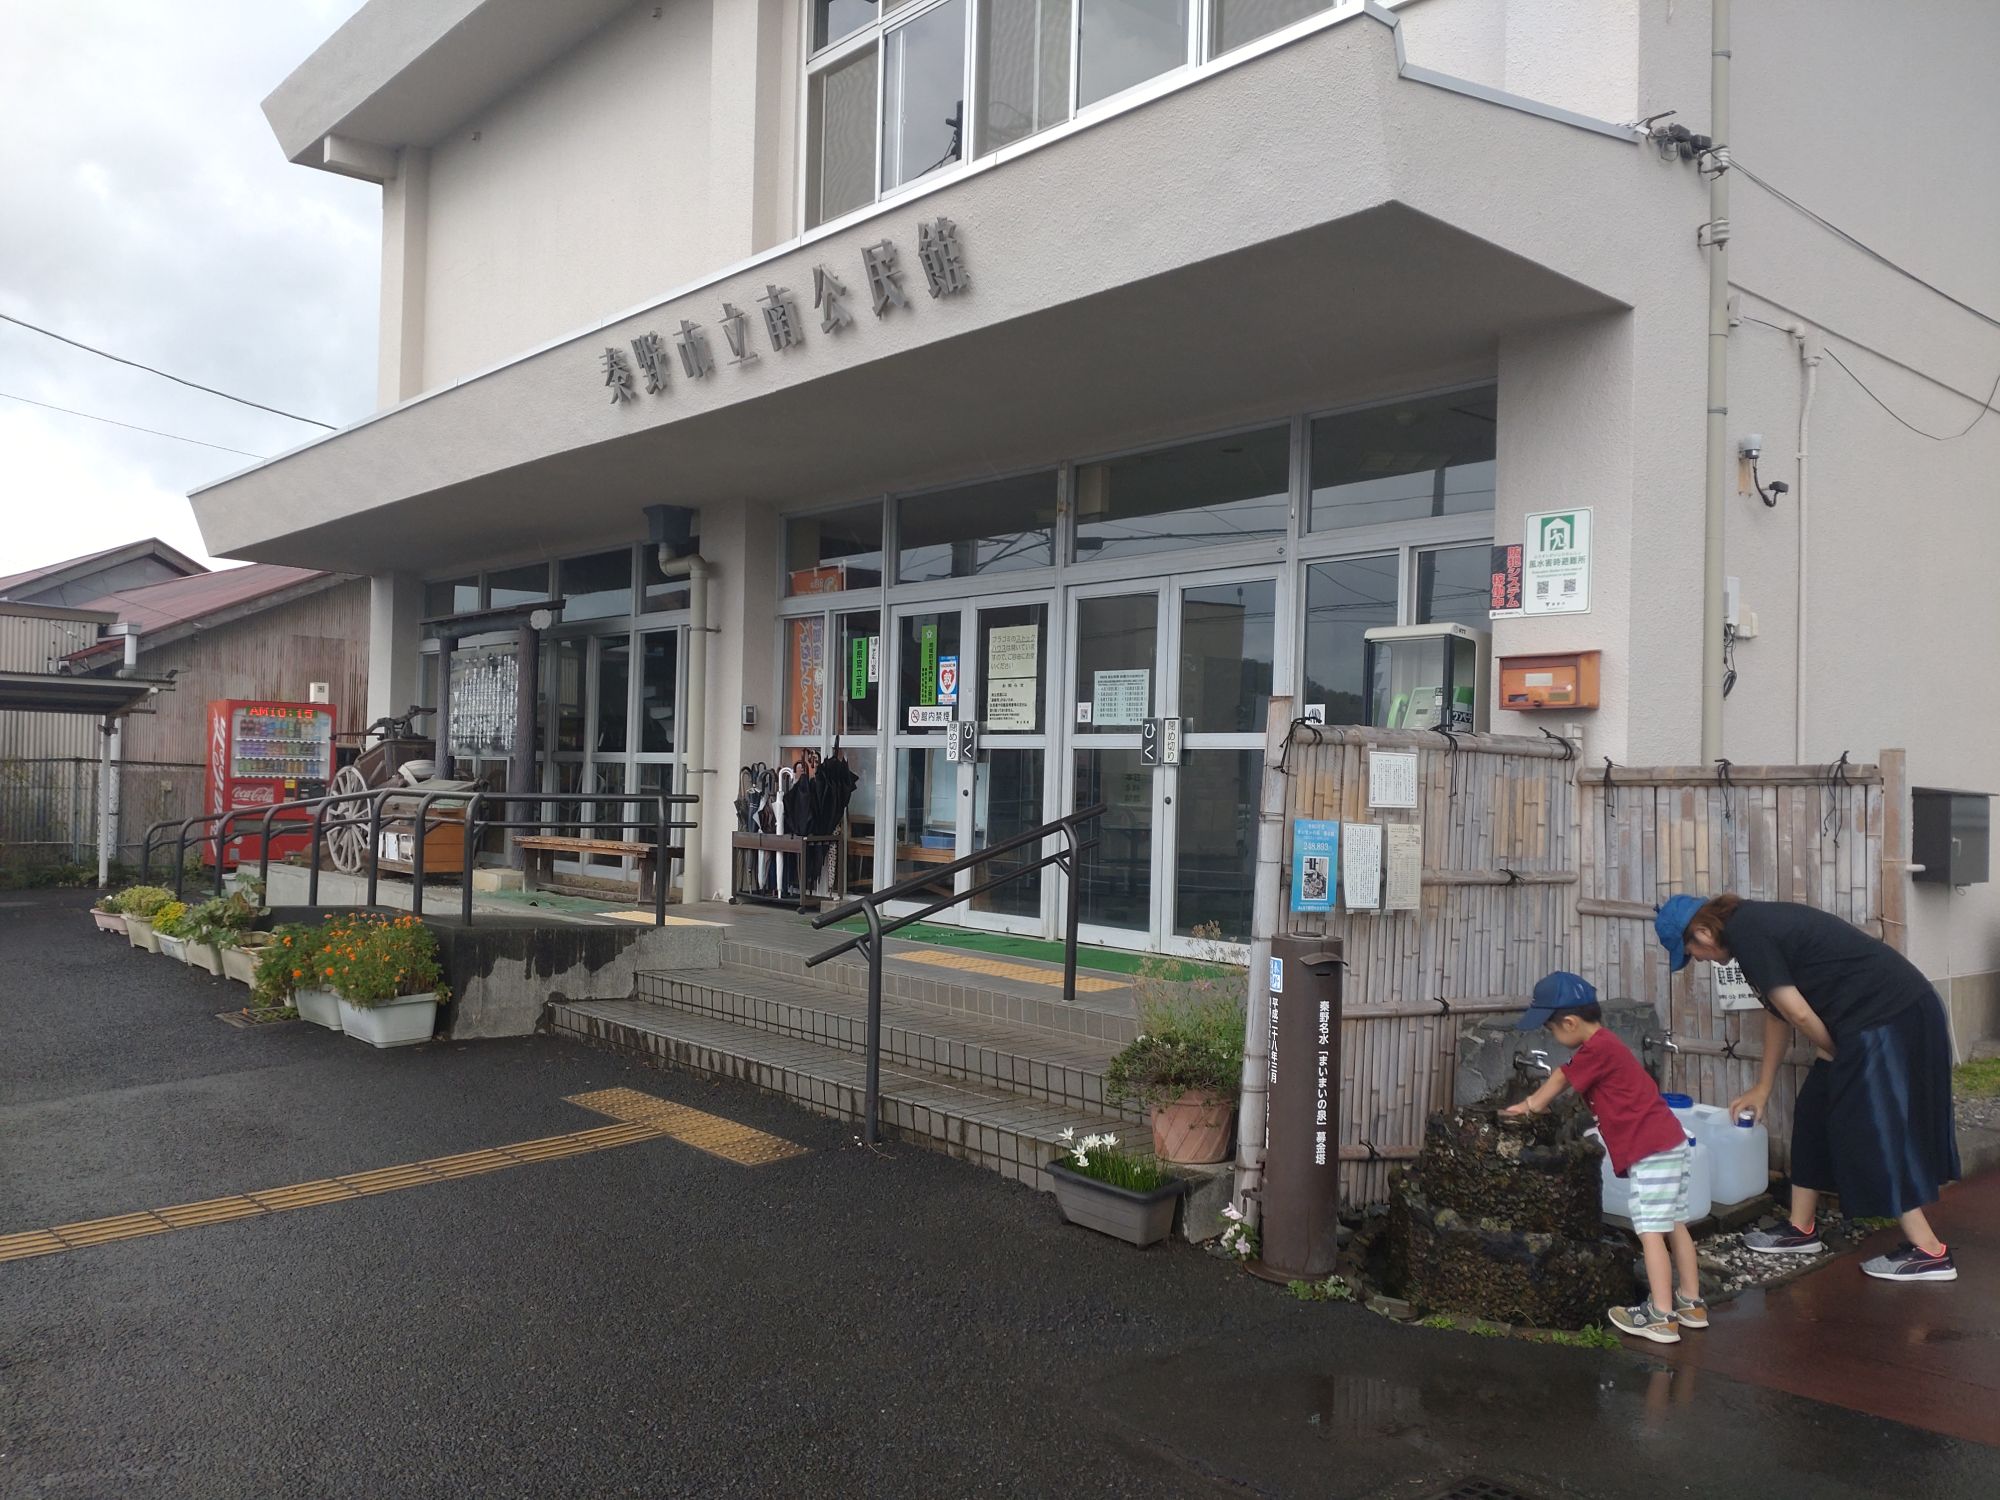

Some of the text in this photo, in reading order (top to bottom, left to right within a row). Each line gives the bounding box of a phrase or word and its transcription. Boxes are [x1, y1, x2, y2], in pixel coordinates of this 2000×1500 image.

[599, 216, 969, 405] 秦野市立南公民館
[1492, 573, 1505, 609] 稼働中
[1506, 546, 1522, 608] 防犯システム
[250, 706, 313, 718] AM10:15
[921, 711, 950, 721] 館内禁煙
[963, 723, 974, 758] ひく
[1144, 723, 1156, 760] ひく
[231, 785, 274, 802] Coca-Cola
[1318, 1000, 1330, 1044] 秦野名水
[1270, 998, 1279, 1084] 平成二十八年三月
[1315, 1131, 1327, 1164] 募金塔
